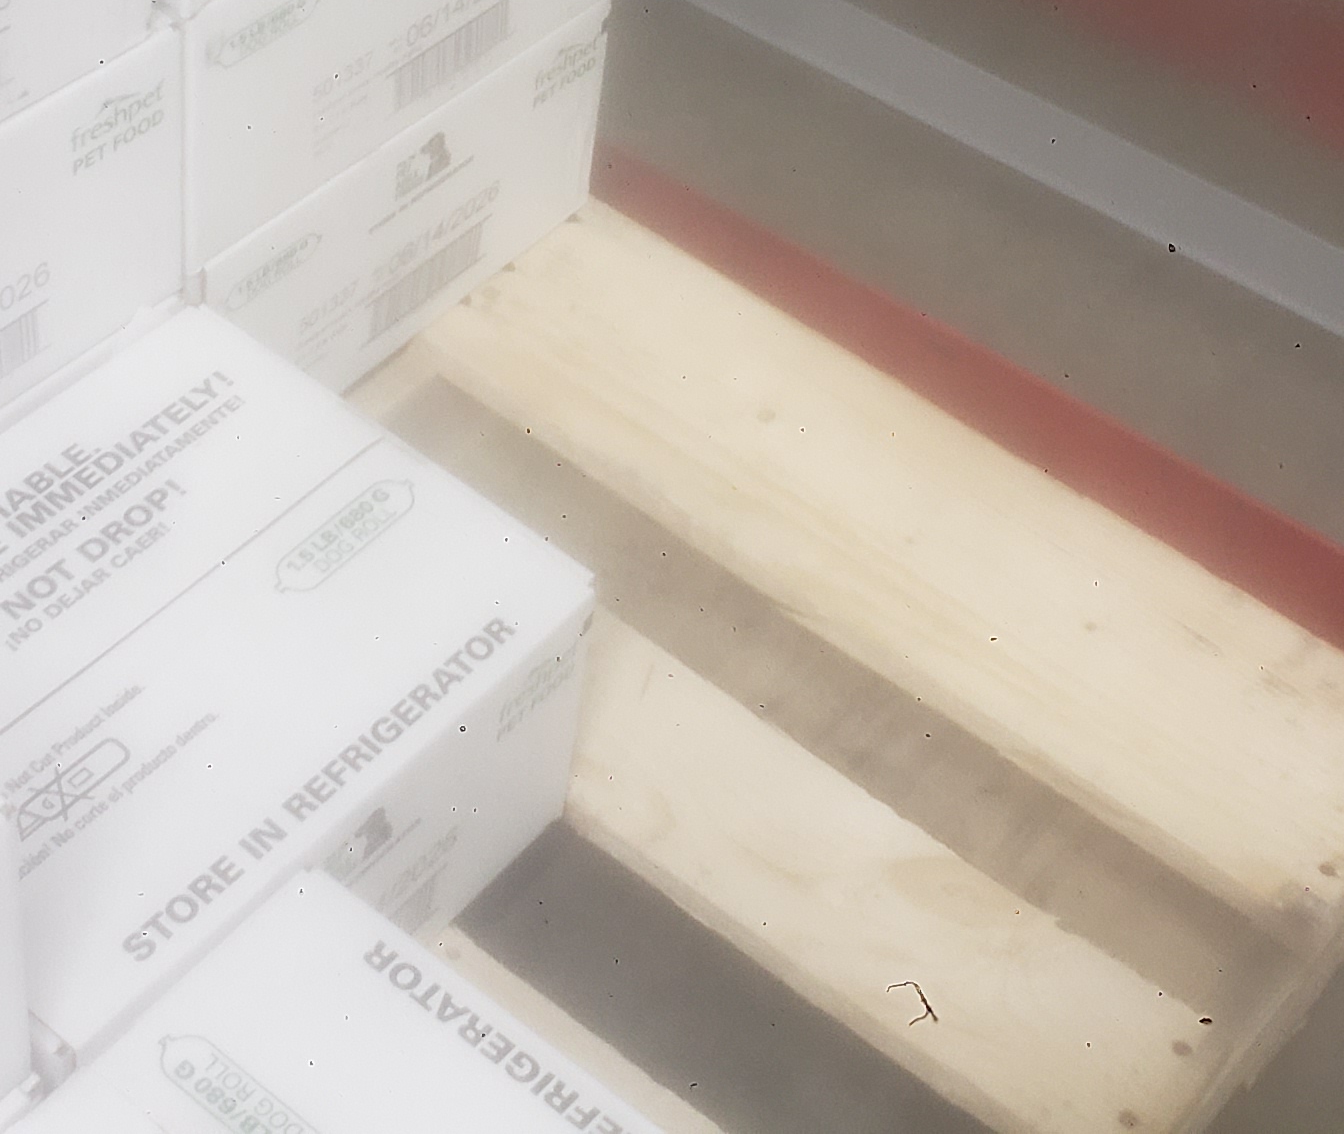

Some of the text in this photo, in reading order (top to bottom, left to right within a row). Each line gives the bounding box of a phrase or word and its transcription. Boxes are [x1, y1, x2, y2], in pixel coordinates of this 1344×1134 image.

[70, 78, 166, 153] freshpet
[71, 110, 166, 176] PET FOOD
[9, 369, 237, 538] IMMEDIATELY!
[76, 393, 247, 524] INMEDIATAMENTE!
[0, 558, 69, 622] NOT
[77, 477, 189, 564] DROP!
[43, 566, 112, 622] DEJAR
[109, 520, 173, 577] CAER!
[121, 852, 247, 964] STORE
[239, 817, 290, 861] IN
[281, 615, 518, 824] REFRIGERATOR
[171, 1058, 197, 1081] G
[204, 1051, 253, 1092] ROLL
[362, 938, 632, 1134] EFRIGERATOR
